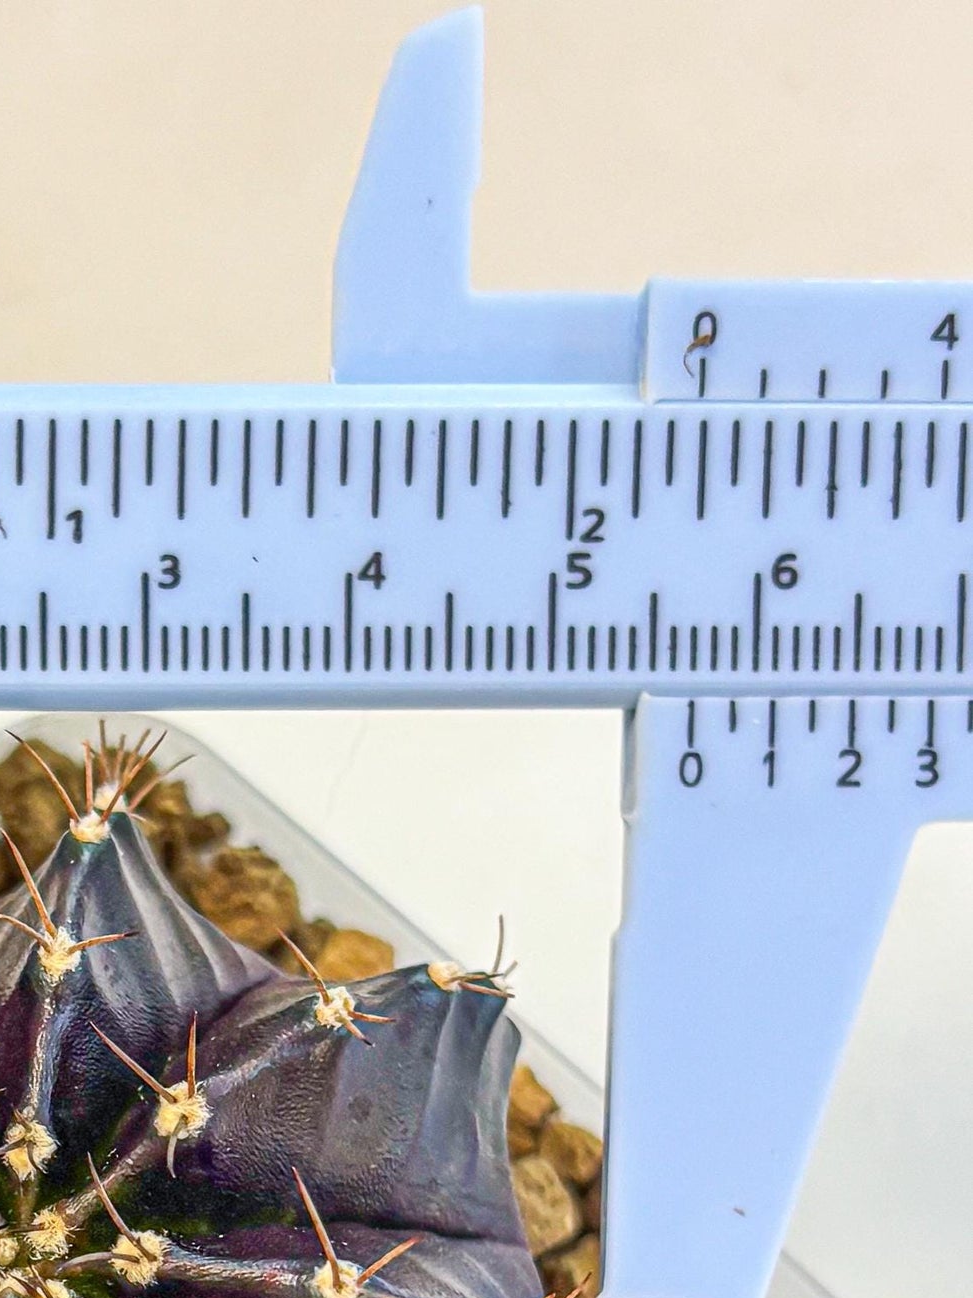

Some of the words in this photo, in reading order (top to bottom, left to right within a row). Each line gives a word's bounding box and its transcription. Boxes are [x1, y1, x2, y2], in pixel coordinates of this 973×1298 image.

[929, 313, 960, 351] 4
[65, 509, 84, 545] 1
[579, 507, 606, 544] 2
[157, 553, 182, 590] 3
[356, 551, 387, 591] 4
[565, 551, 593, 590] 5
[771, 552, 799, 591] 6
[678, 751, 704, 788] 0
[761, 750, 776, 788] 1
[836, 750, 863, 788] 2
[915, 750, 940, 789] 3
